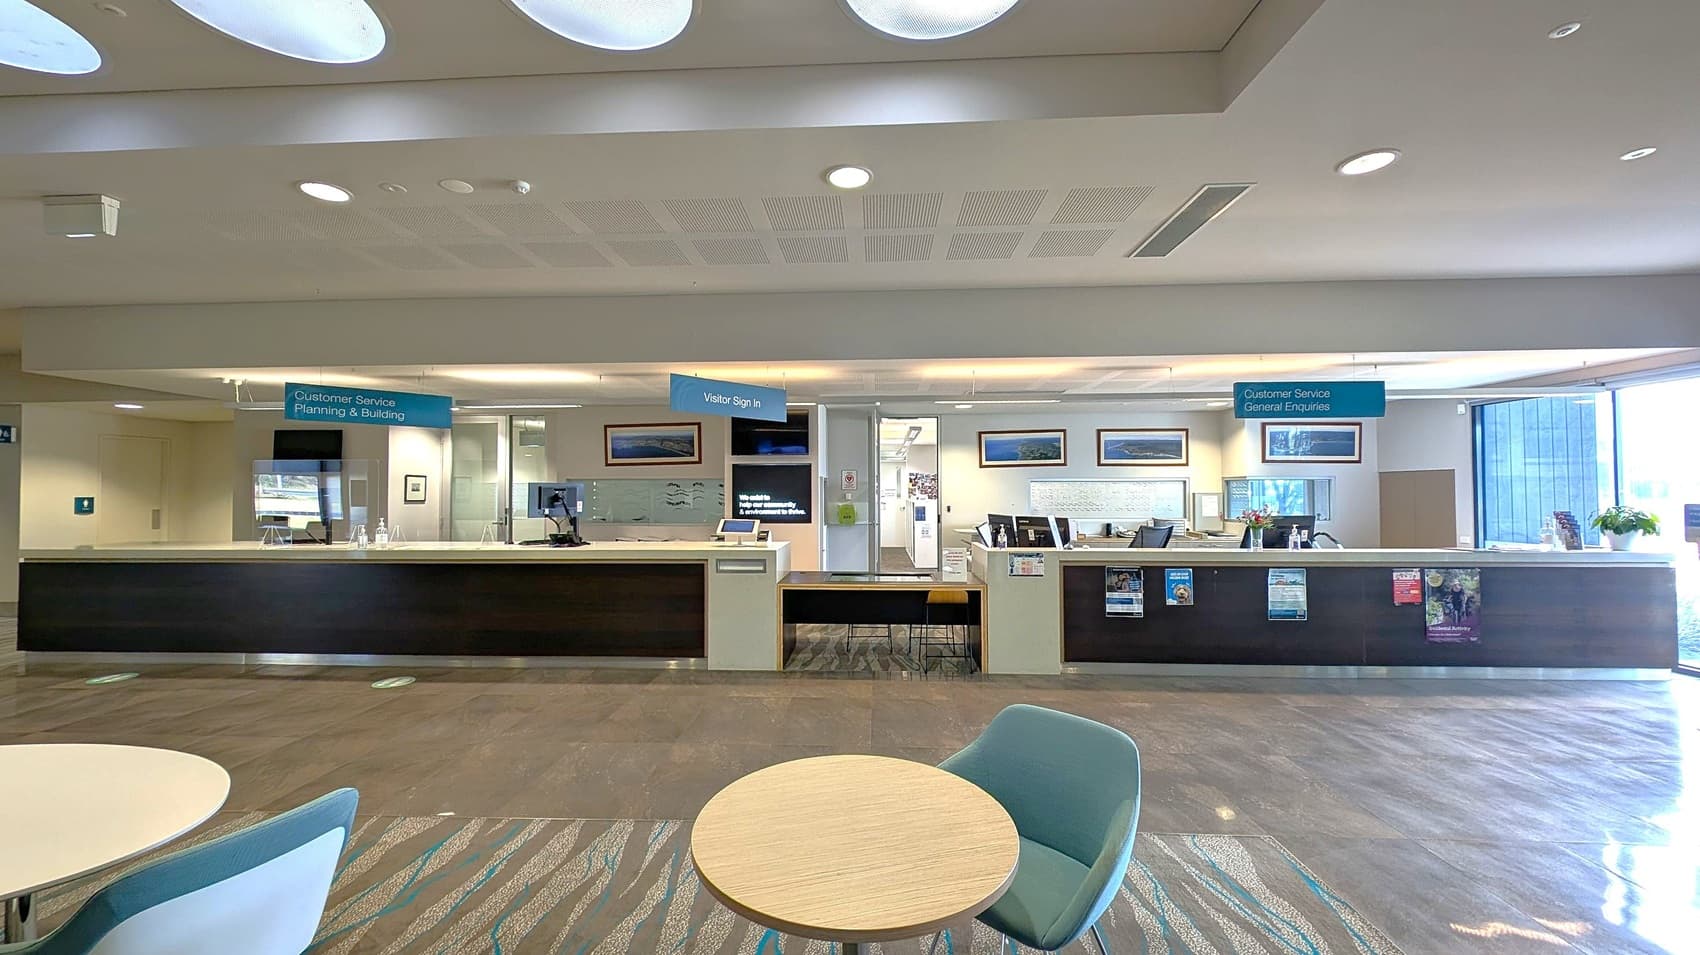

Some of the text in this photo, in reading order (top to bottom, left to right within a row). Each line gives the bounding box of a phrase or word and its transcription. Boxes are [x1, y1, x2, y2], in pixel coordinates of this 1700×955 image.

[294, 390, 396, 407] Customer Service
[703, 391, 761, 409] Visitor Sign In
[1244, 389, 1330, 399] Customer Service
[294, 404, 405, 422] Planning & Building
[1244, 401, 1330, 413] General Enquiries
[739, 501, 753, 509] help
[763, 501, 797, 509] community
